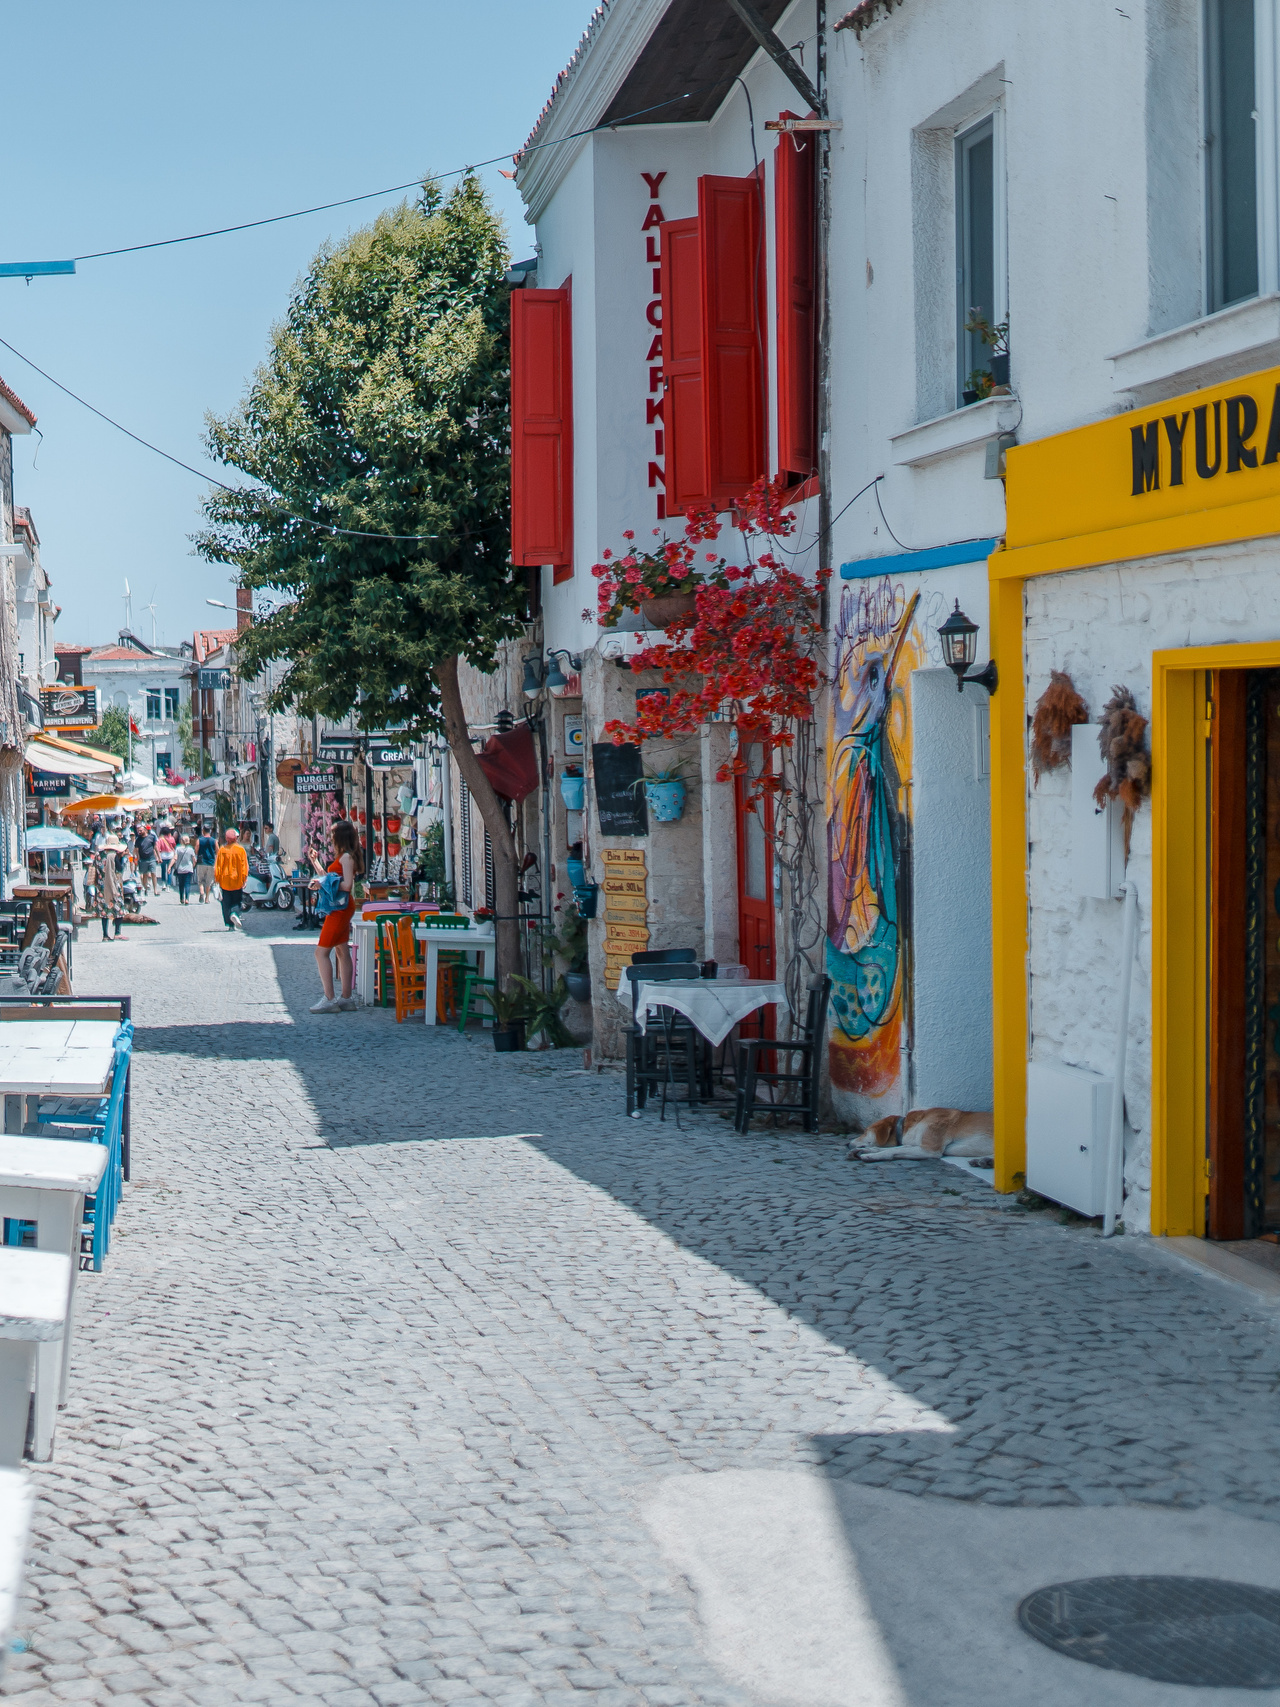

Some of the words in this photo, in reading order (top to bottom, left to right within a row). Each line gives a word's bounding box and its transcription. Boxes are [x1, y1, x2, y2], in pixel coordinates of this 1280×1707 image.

[33, 779, 66, 787] KARMEN
[296, 774, 335, 784] BURGER
[296, 783, 336, 793] REPUBLIC
